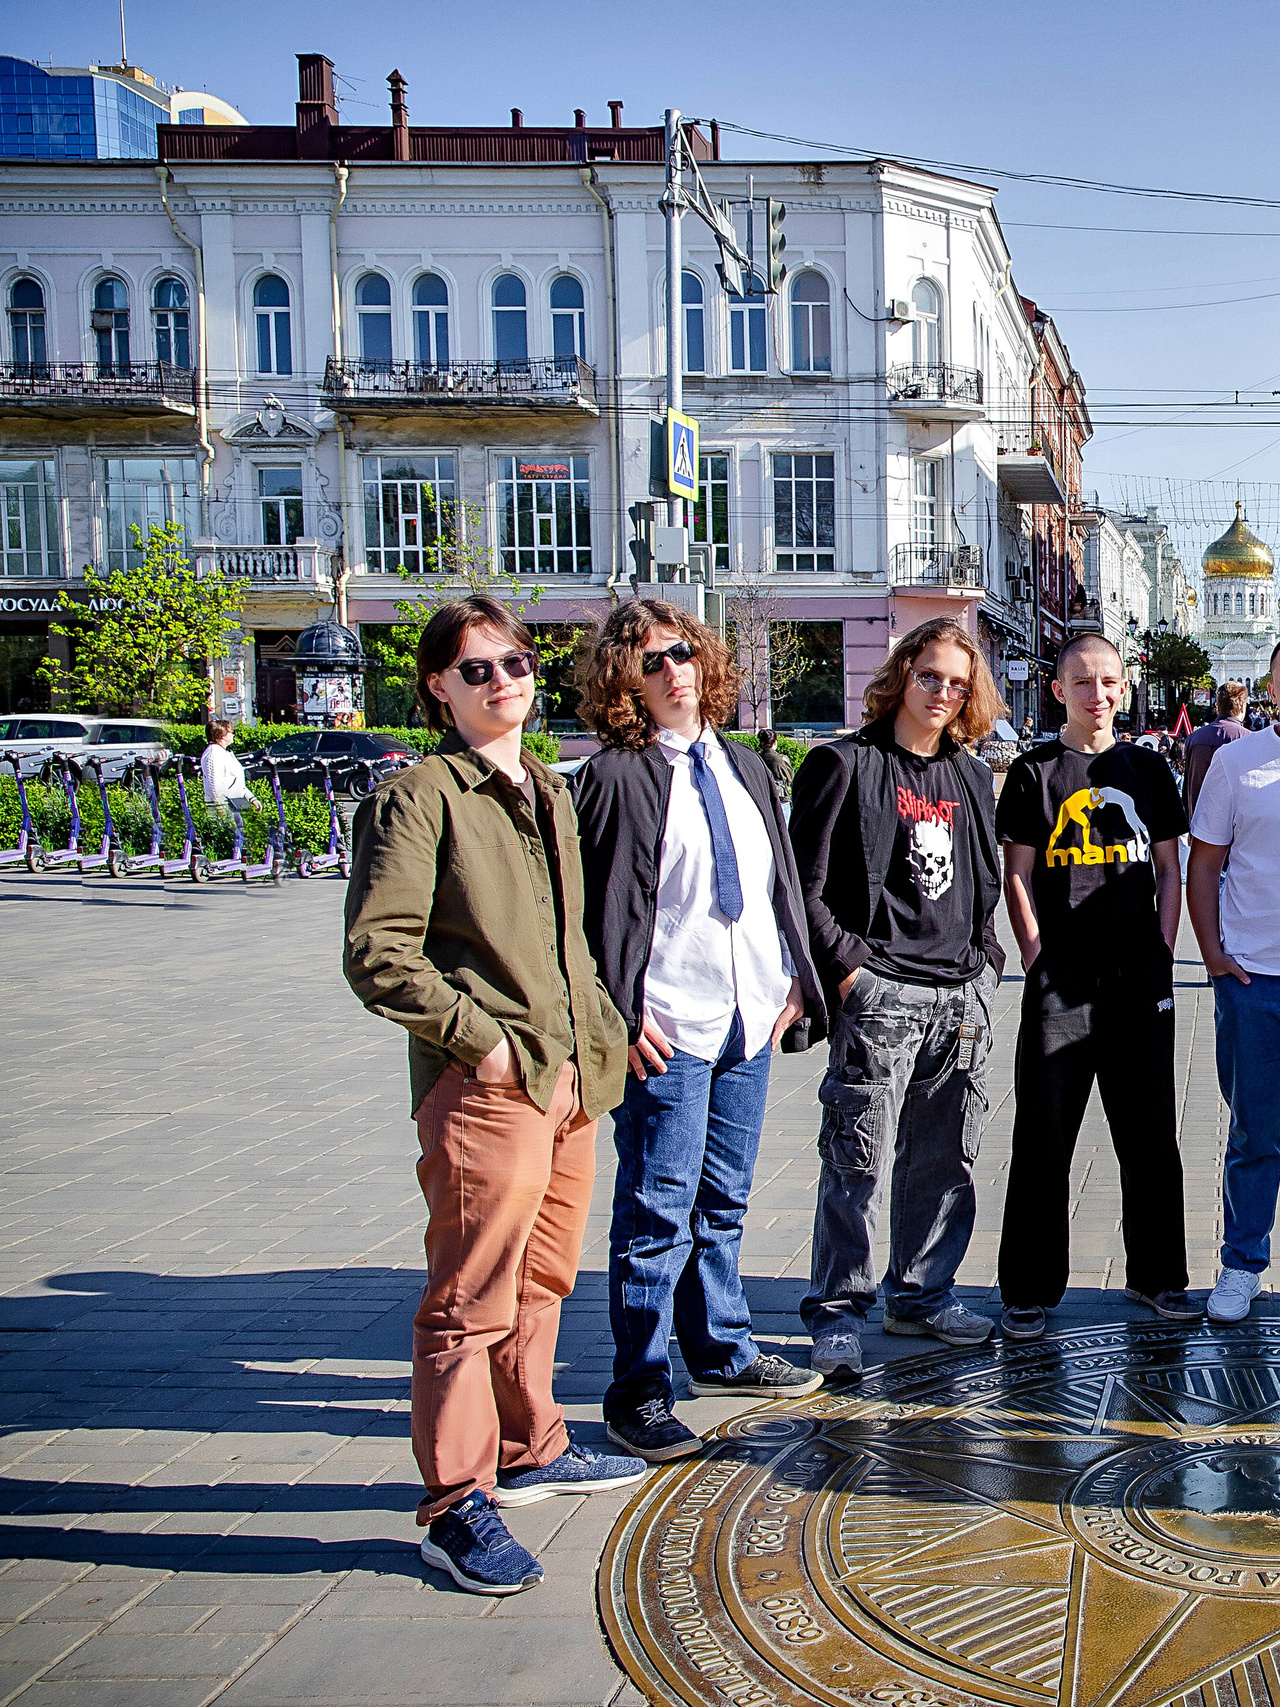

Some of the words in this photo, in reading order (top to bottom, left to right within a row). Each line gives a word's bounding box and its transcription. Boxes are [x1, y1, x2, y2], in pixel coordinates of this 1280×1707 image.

[764, 1461, 828, 1502] 6004
[656, 1515, 703, 1569] ТОКИО
[680, 1457, 754, 1507] ПЕКИН
[743, 1514, 791, 1556] 7871
[760, 1596, 830, 1645] 6819
